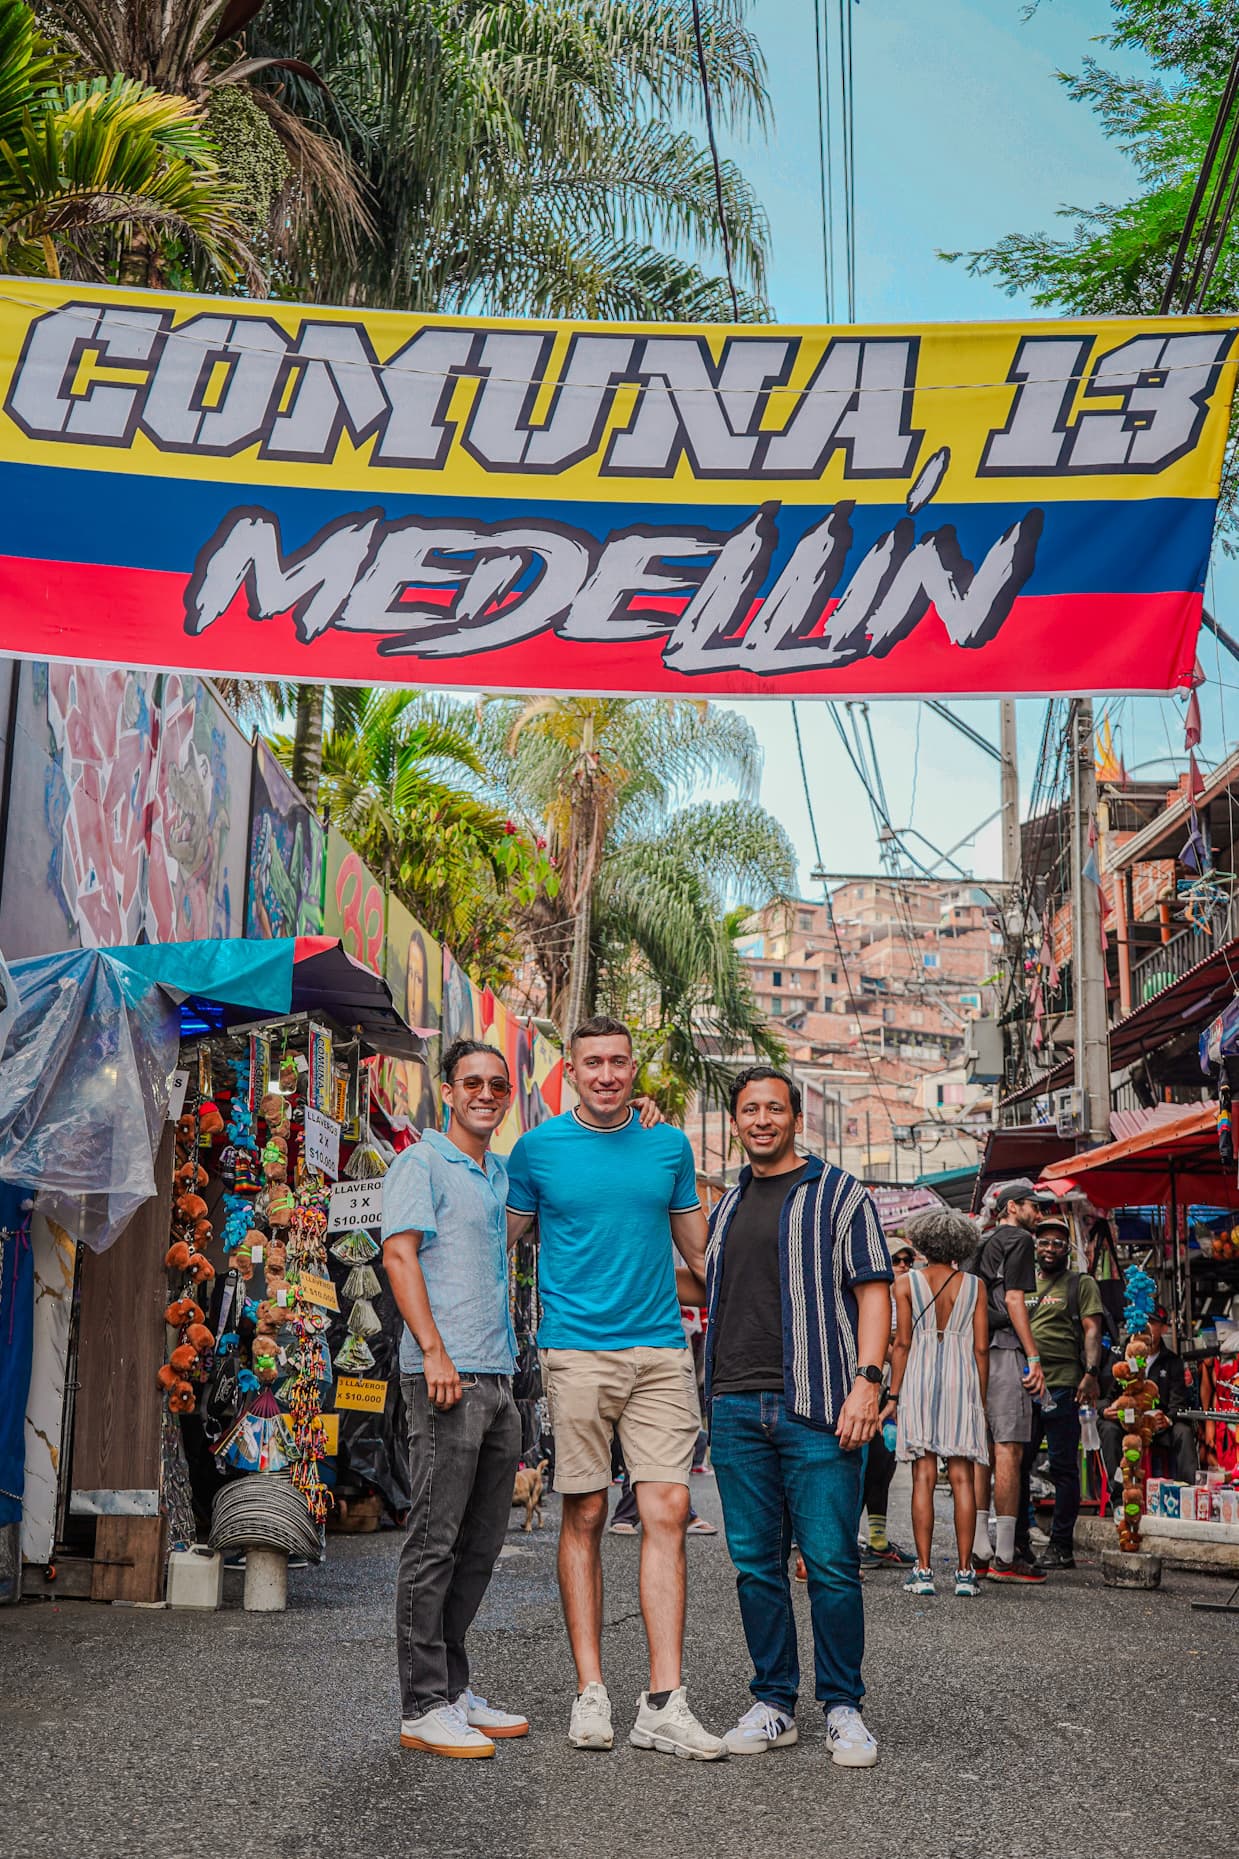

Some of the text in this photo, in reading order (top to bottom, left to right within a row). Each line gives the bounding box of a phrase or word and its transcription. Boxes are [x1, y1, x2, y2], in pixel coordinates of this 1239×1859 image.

[2, 300, 1238, 480] COMUNA 13
[183, 447, 1044, 677] MEDELLÍN
[307, 1111, 338, 1137] LLAVEROS
[309, 1147, 336, 1172] $10.000
[349, 1197, 371, 1209] 3 X
[345, 1380, 385, 1391] LLAVEROS
[345, 1392, 382, 1403] $10.000
